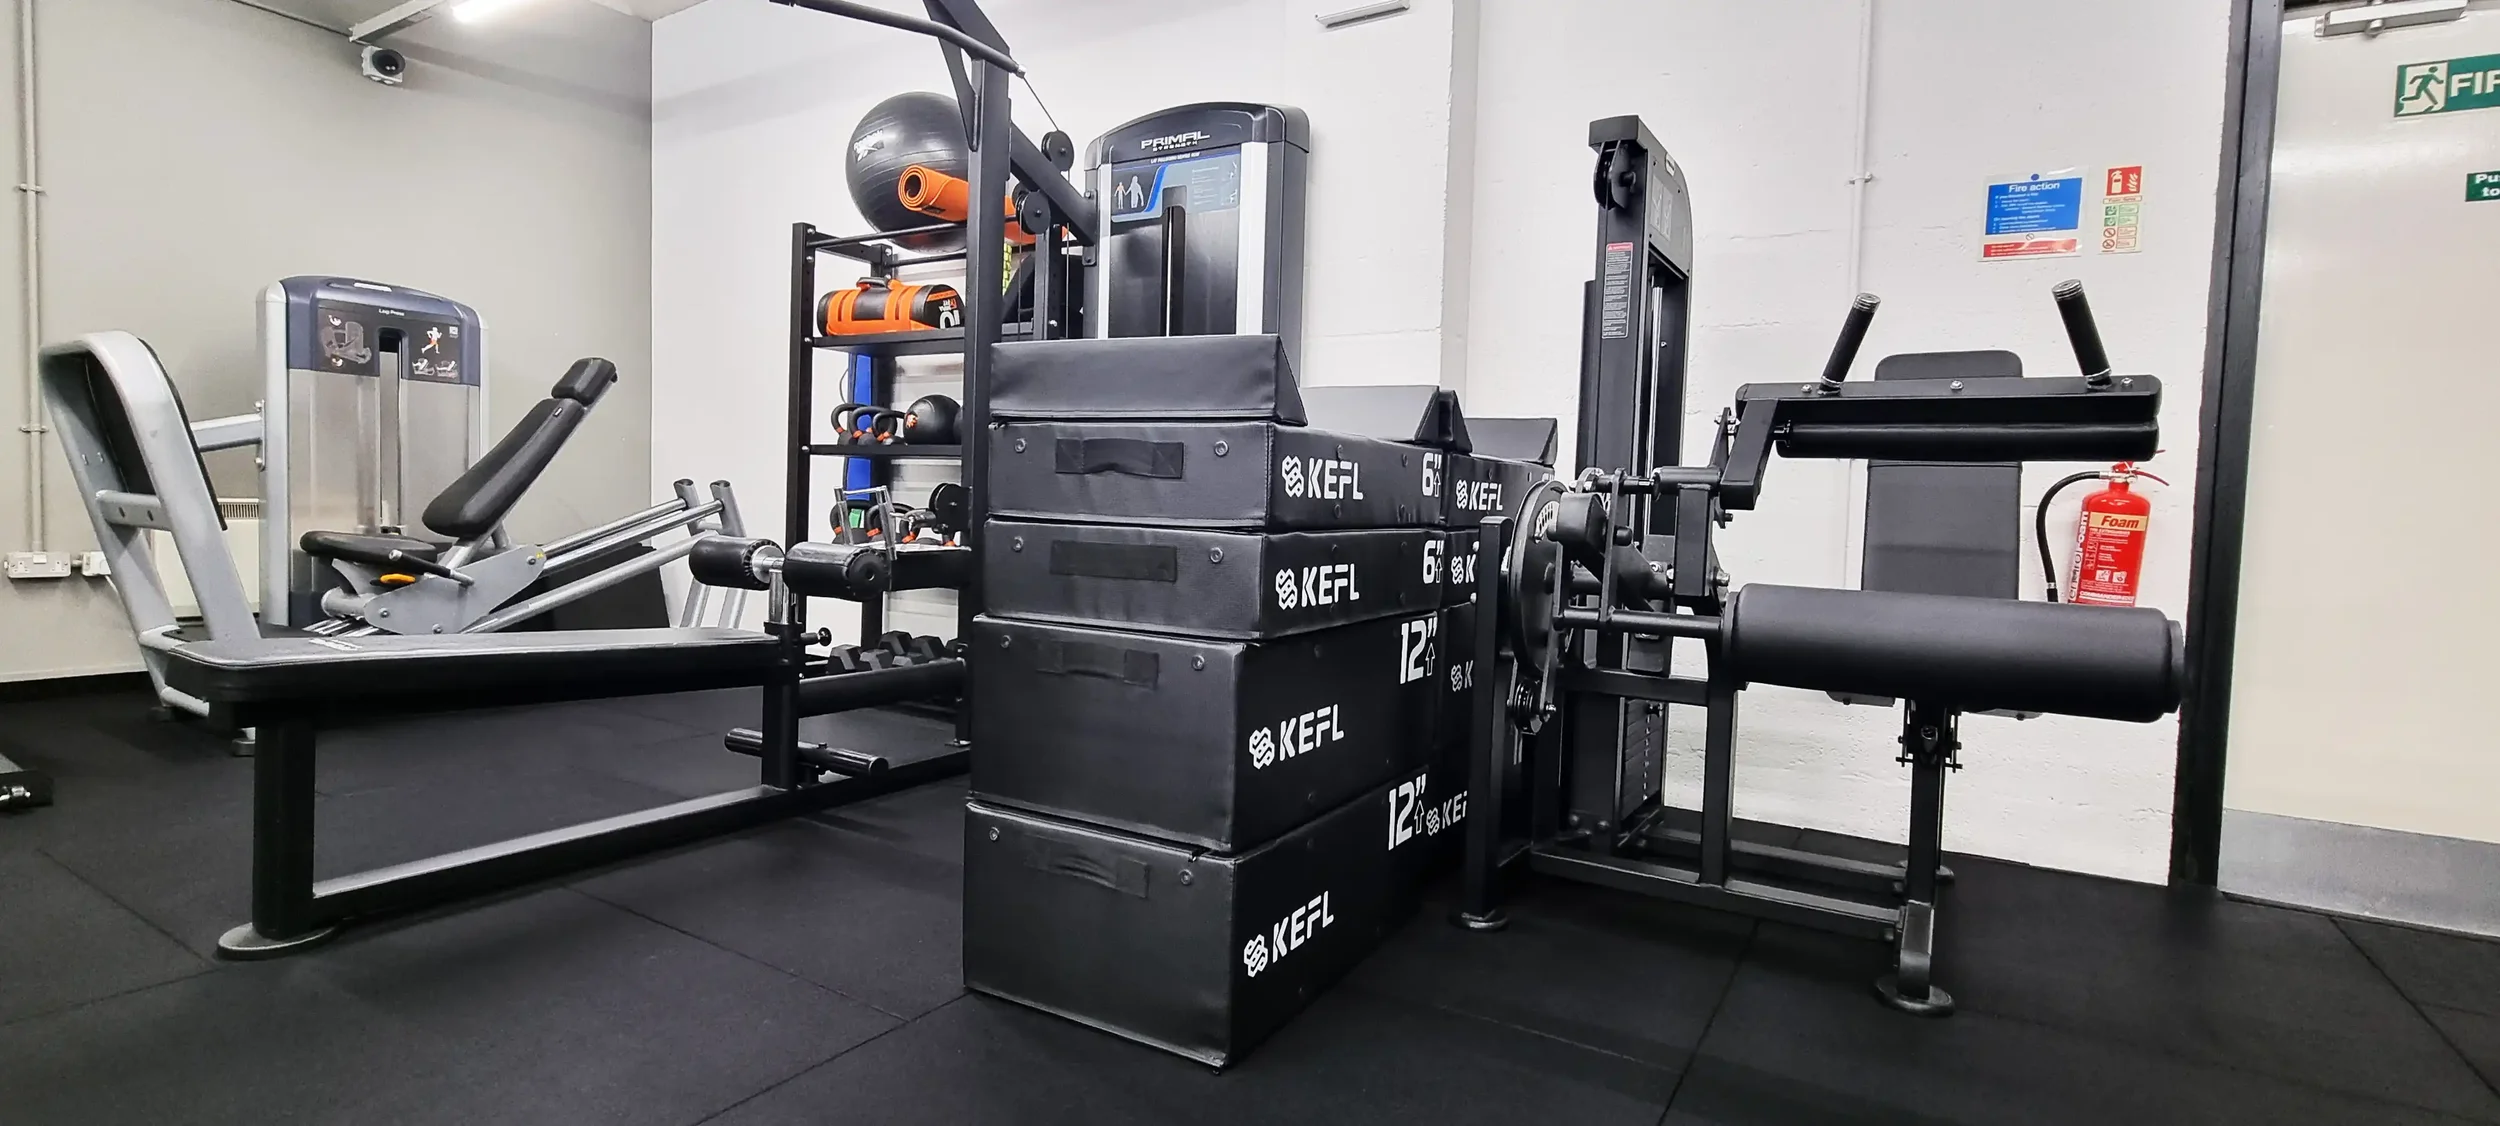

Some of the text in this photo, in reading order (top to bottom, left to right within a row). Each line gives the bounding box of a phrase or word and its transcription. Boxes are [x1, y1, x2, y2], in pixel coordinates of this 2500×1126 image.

[1141, 131, 1210, 149] PRIMAL
[2009, 182, 2060, 193] Fire action
[1308, 458, 1364, 500] KEFL
[1469, 480, 1503, 511] KEFL
[2101, 515, 2139, 528] Foam
[1301, 563, 1360, 607] KEFL
[1280, 704, 1344, 761] KEFL
[1442, 791, 1468, 829] KE
[1272, 890, 1335, 964] KEFL
